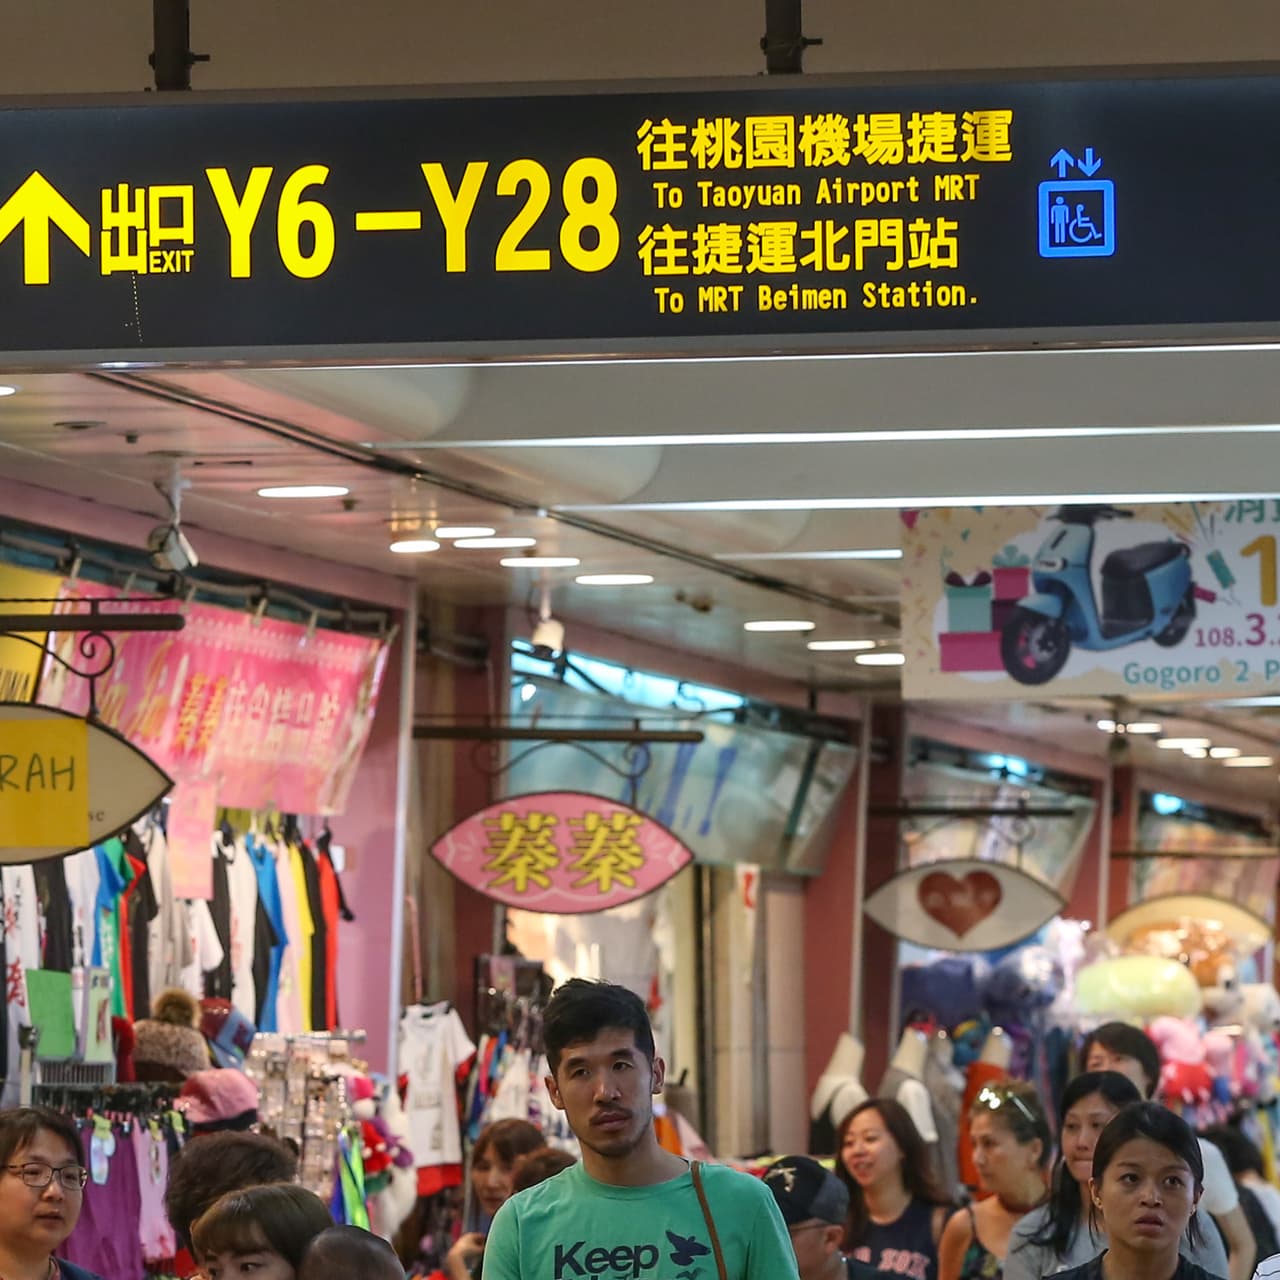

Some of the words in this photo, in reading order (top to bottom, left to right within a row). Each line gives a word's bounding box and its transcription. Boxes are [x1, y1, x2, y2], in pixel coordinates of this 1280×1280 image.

[637, 109, 1012, 170] 往桃園機場捷運
[653, 183, 683, 208] To
[696, 181, 801, 210] Taoyuan
[817, 177, 919, 205] Airport
[934, 174, 980, 202] MRT
[101, 183, 195, 275] 出口
[638, 216, 958, 276] 往捷運北門站
[149, 249, 195, 274] EXIT
[654, 288, 684, 313] To
[698, 286, 744, 313] MRT
[758, 283, 847, 310] Beimen
[863, 280, 977, 308] Station.
[1123, 661, 1221, 690] Gogoro
[1234, 660, 1251, 682] 2
[481, 811, 645, 894] 蓁蓁
[553, 1241, 659, 1280] Keep
